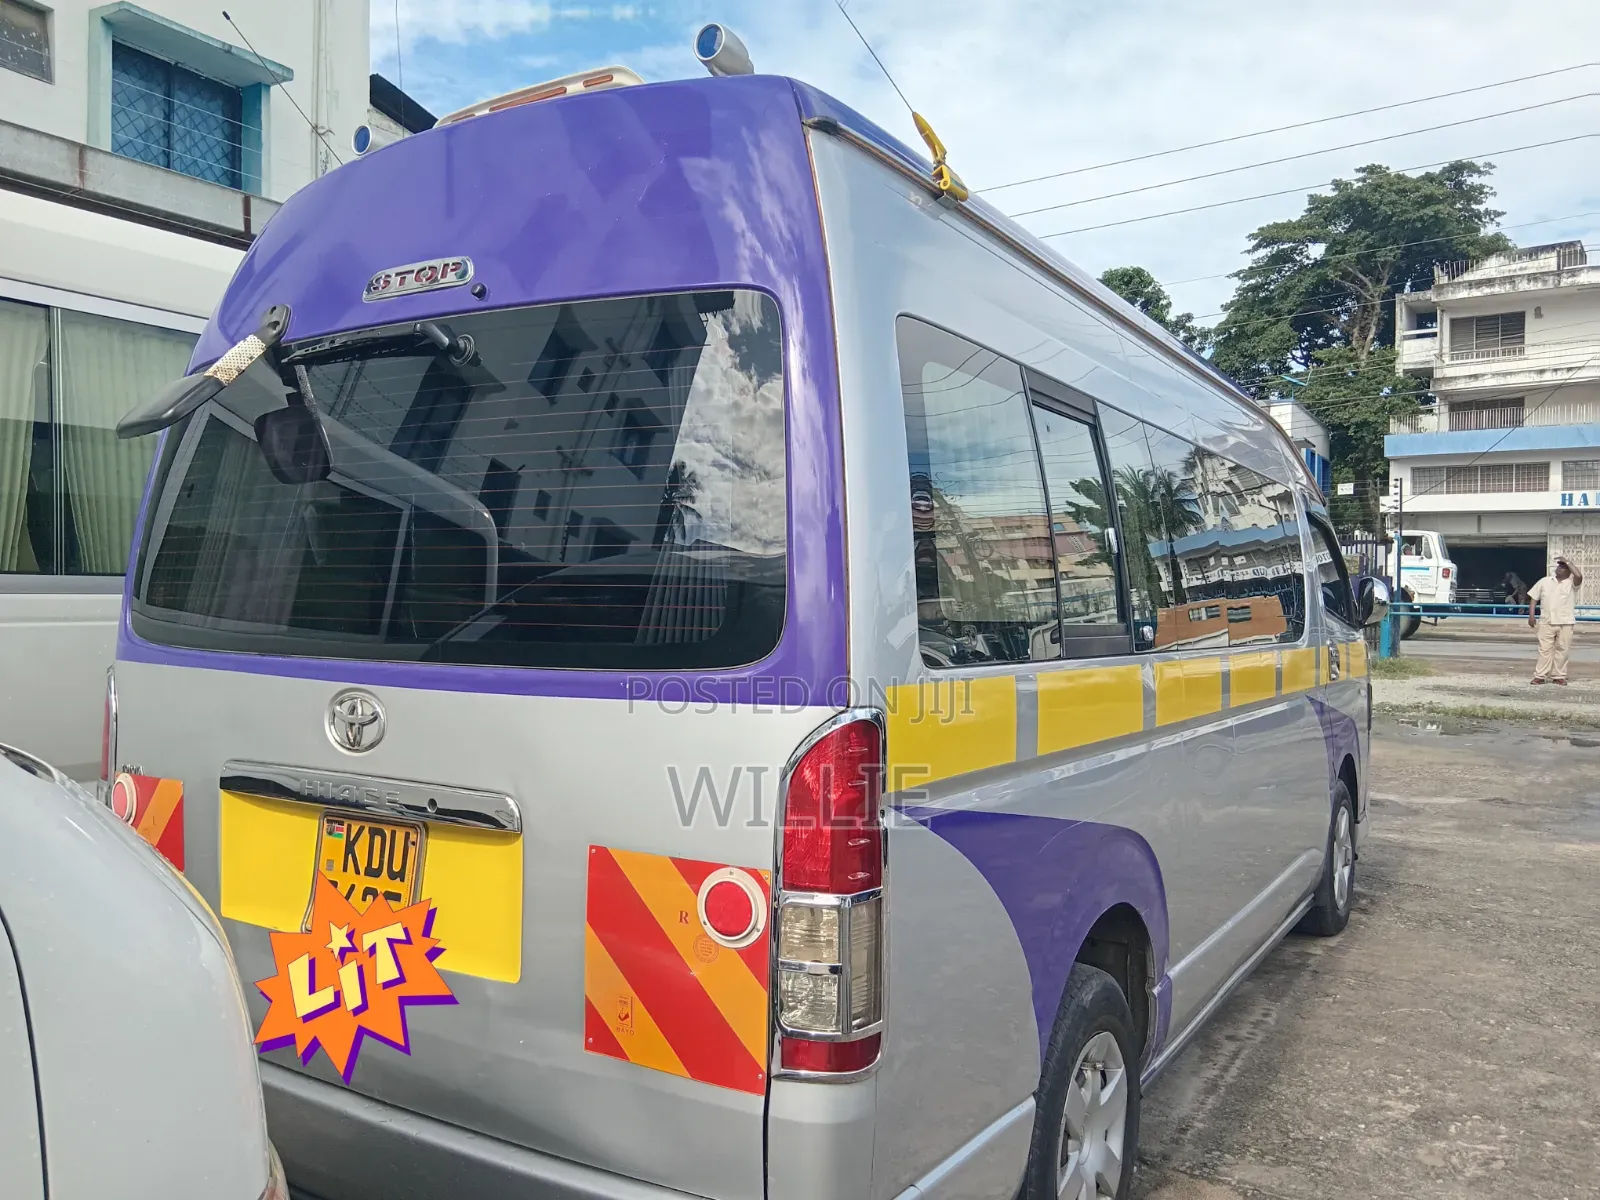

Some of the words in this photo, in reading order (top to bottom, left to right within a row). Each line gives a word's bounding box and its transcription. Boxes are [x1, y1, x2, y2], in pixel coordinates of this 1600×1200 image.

[371, 261, 463, 292] STOP
[300, 778, 401, 807] HIACE
[342, 823, 411, 883] KDU
[679, 910, 689, 925] R
